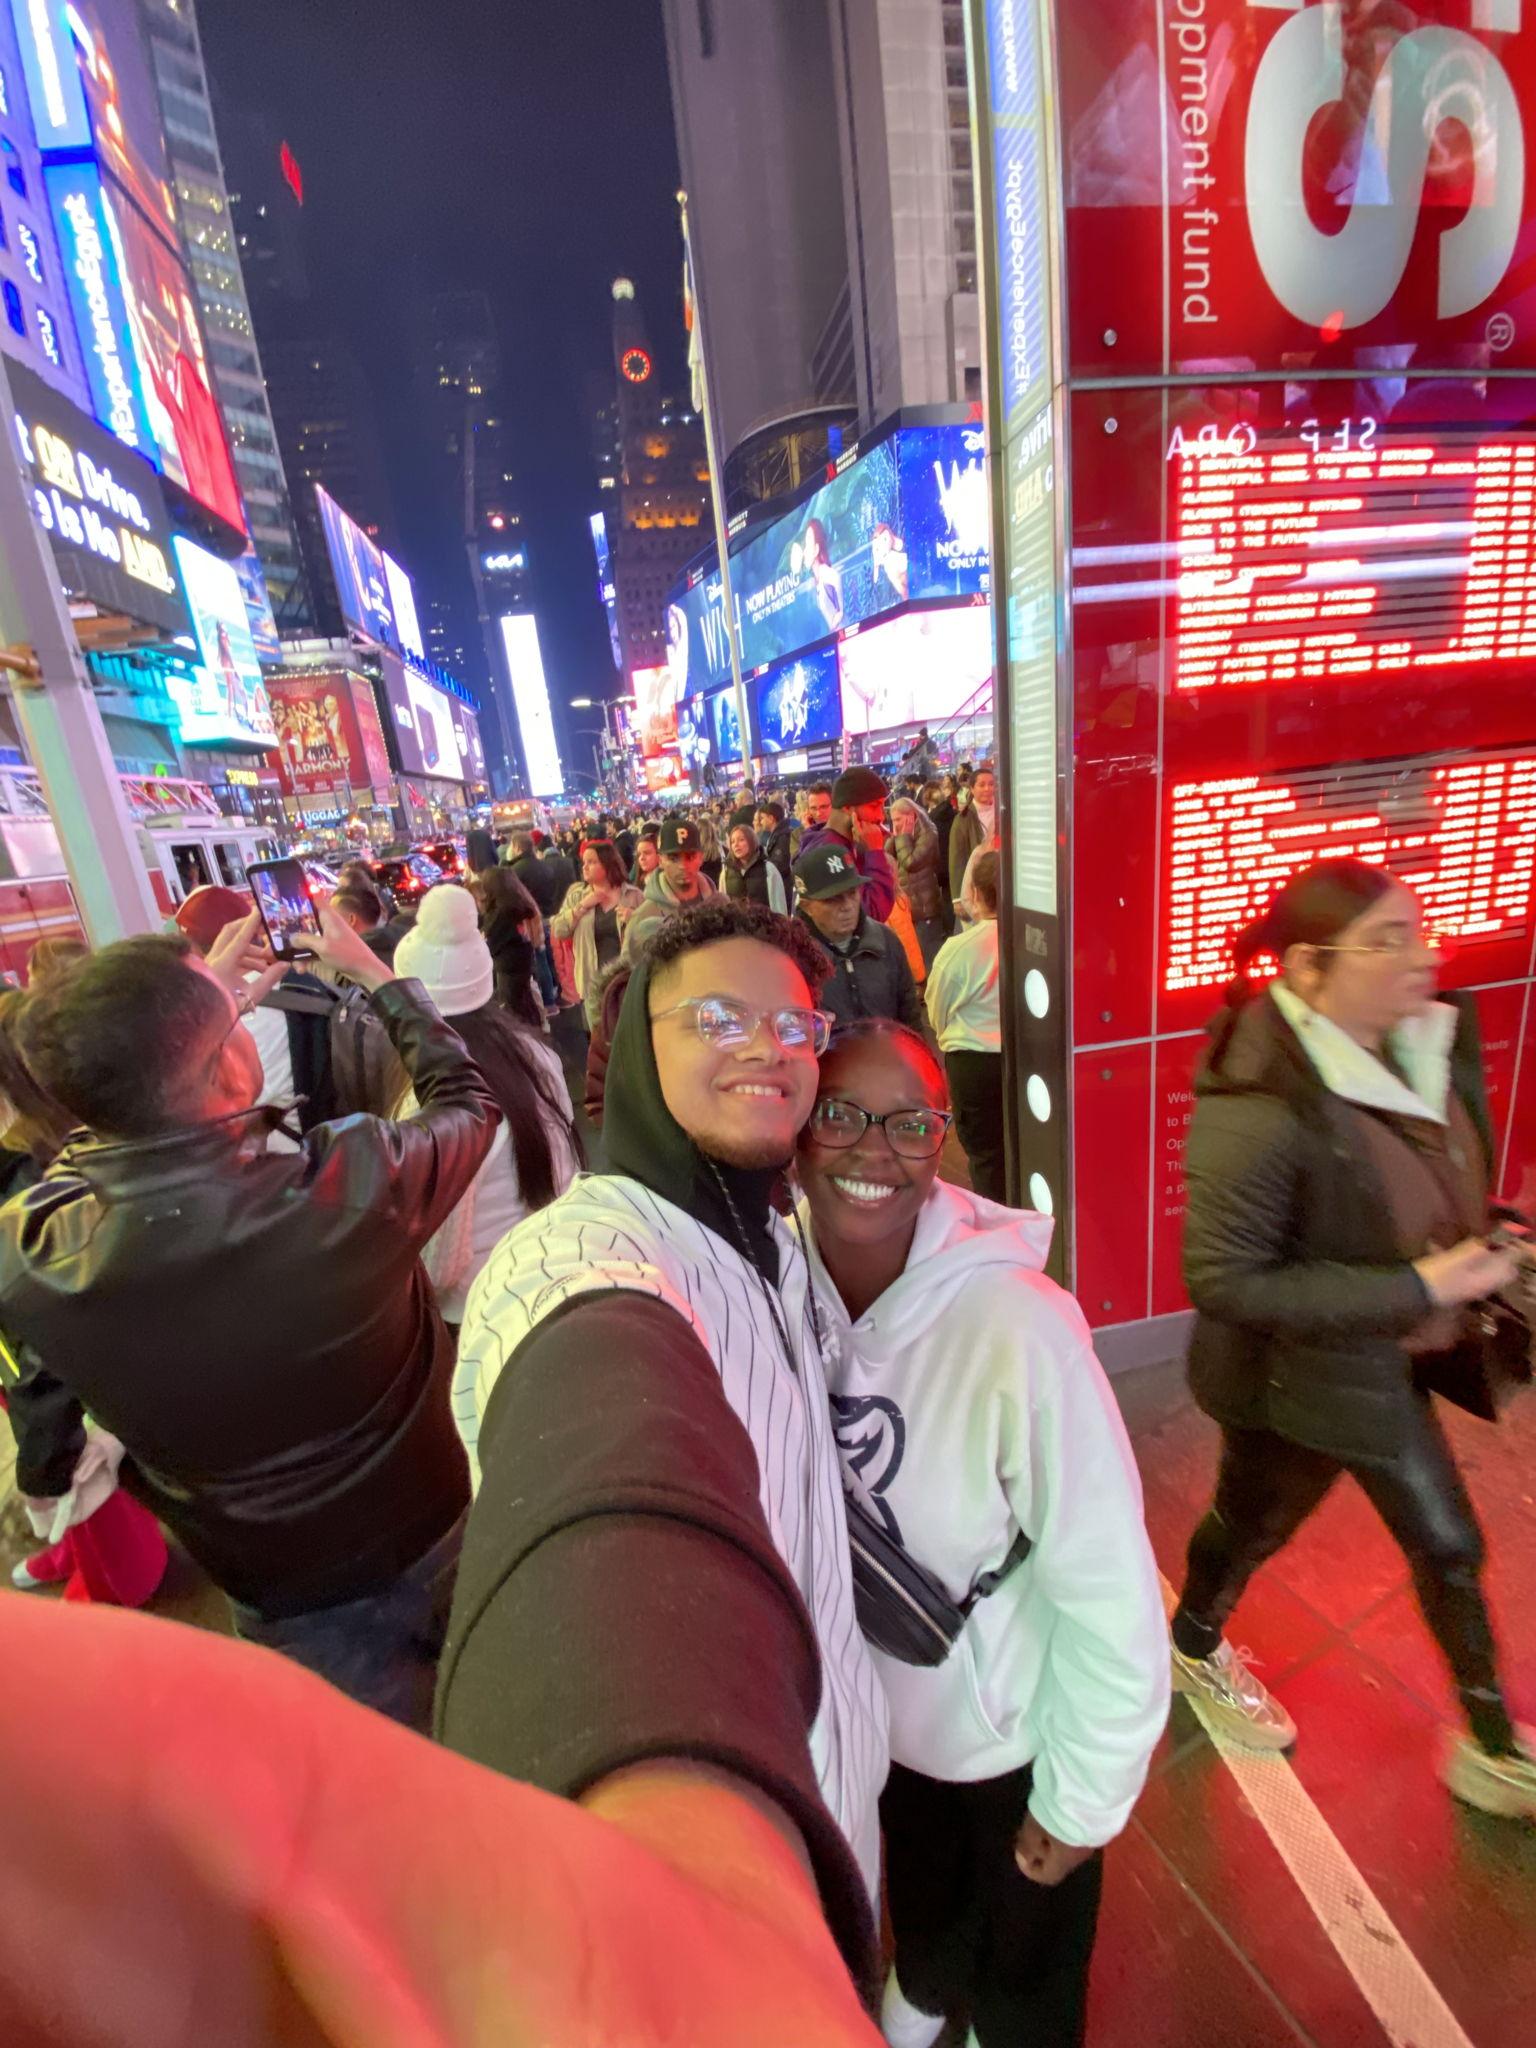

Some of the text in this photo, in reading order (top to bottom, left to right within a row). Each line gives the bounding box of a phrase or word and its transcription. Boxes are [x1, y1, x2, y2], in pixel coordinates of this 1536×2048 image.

[1169, 0, 1219, 323] opment fund
[64, 192, 139, 448] #ExperienceEgypt
[34, 425, 83, 500] OR
[51, 488, 85, 545] Is
[81, 505, 121, 563] No
[120, 527, 176, 595] AND.
[1218, 521, 1236, 534] TO
[1242, 519, 1267, 532] THE
[948, 557, 977, 570] ONLY
[746, 571, 800, 615] NOW PLAYING
[284, 756, 351, 777] HARMONY
[1167, 1114, 1178, 1127] to
